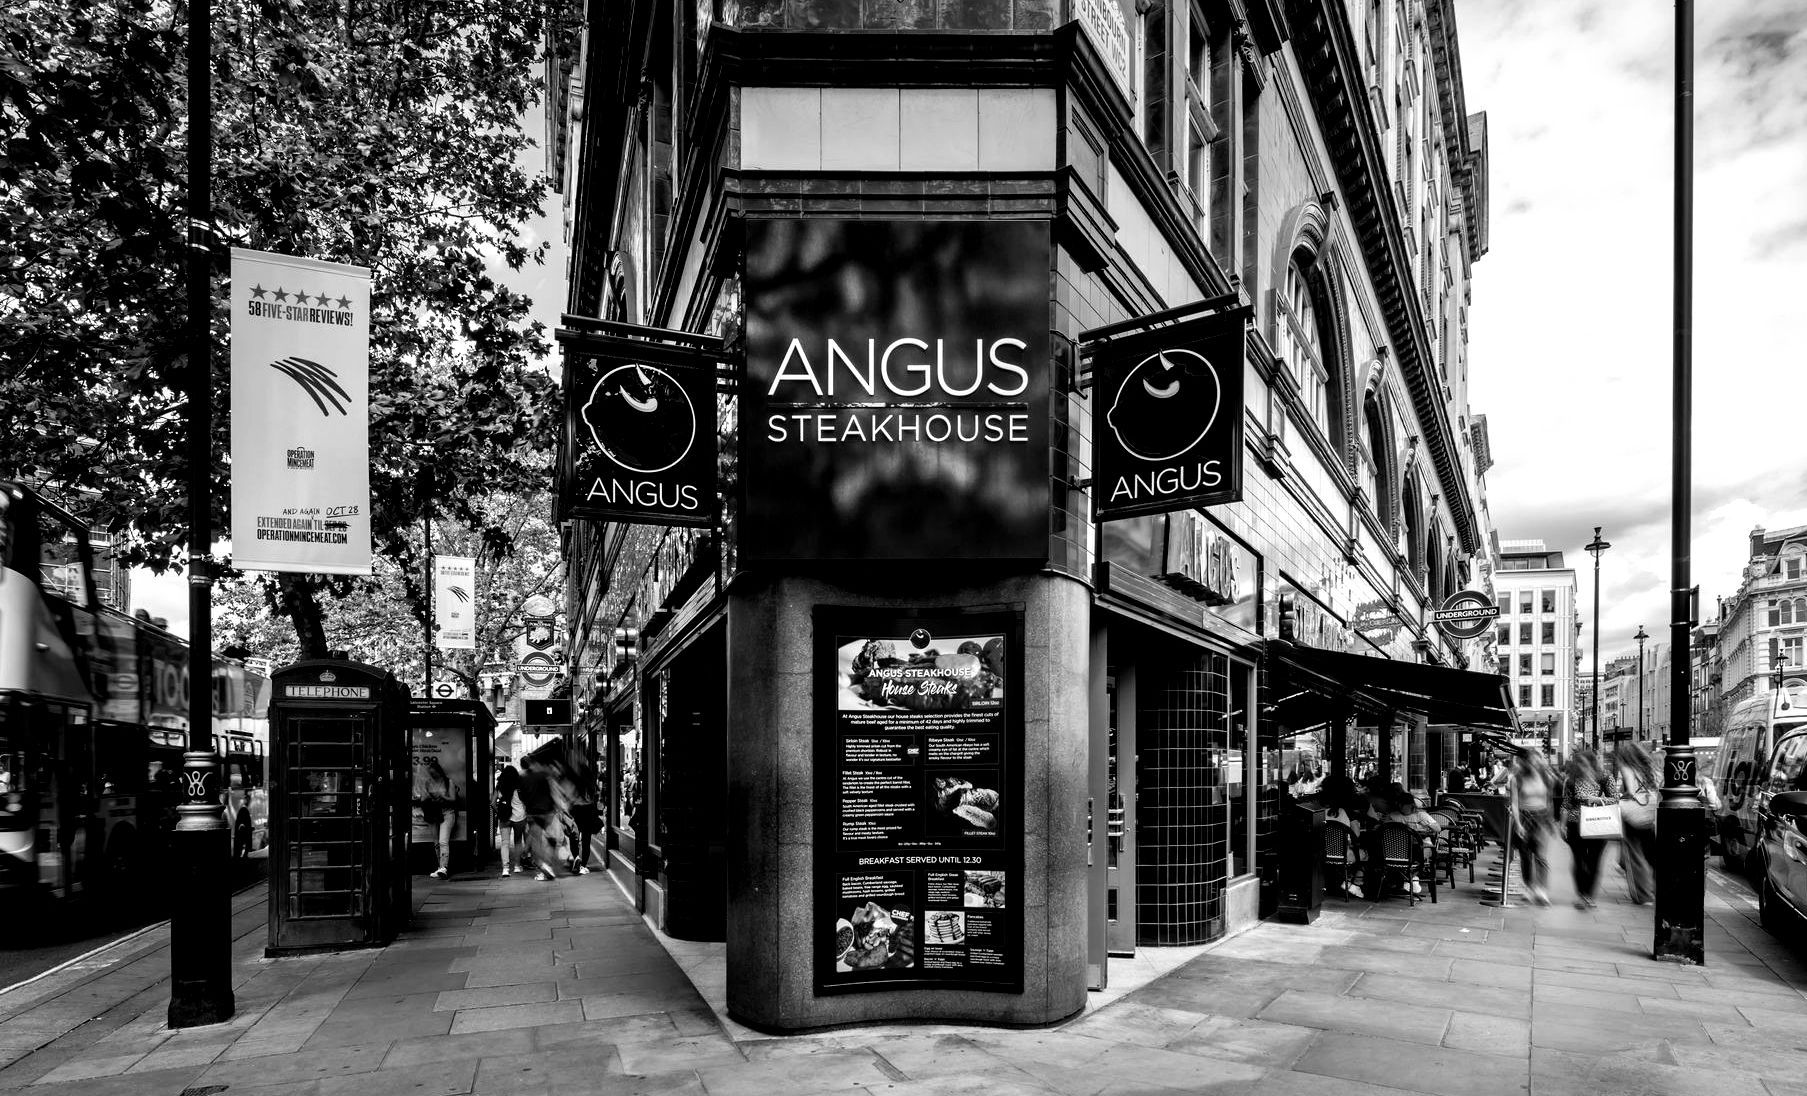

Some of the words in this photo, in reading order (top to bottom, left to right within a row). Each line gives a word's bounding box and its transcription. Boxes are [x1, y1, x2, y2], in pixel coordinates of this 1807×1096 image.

[249, 300, 262, 317] 58
[262, 302, 309, 322] FIVE-STAR
[310, 308, 354, 327] REVIEWS!
[767, 337, 1029, 397] ANGUS
[767, 414, 1029, 442] STEAKHOUSE
[287, 450, 314, 459] OPERATION
[287, 458, 314, 468] MINCEMEAT
[1110, 460, 1222, 502] ANGUS
[586, 477, 698, 510] ANGUS
[326, 506, 346, 516] OCT
[348, 506, 359, 514] 28
[257, 516, 292, 530] EXTENDED
[292, 518, 312, 530] AGAIN
[314, 520, 324, 530] TIL
[257, 529, 348, 544] OPERATIONMINCEMEAT.COM
[1436, 608, 1498, 619] UNDERGROUND
[868, 668, 902, 678] ANGUS
[905, 668, 971, 678] STEAKHOUSE
[292, 686, 367, 698] TELEPHONE
[882, 680, 915, 699] House
[917, 680, 958, 696] Steaks
[859, 856, 904, 865] BREAKFAST
